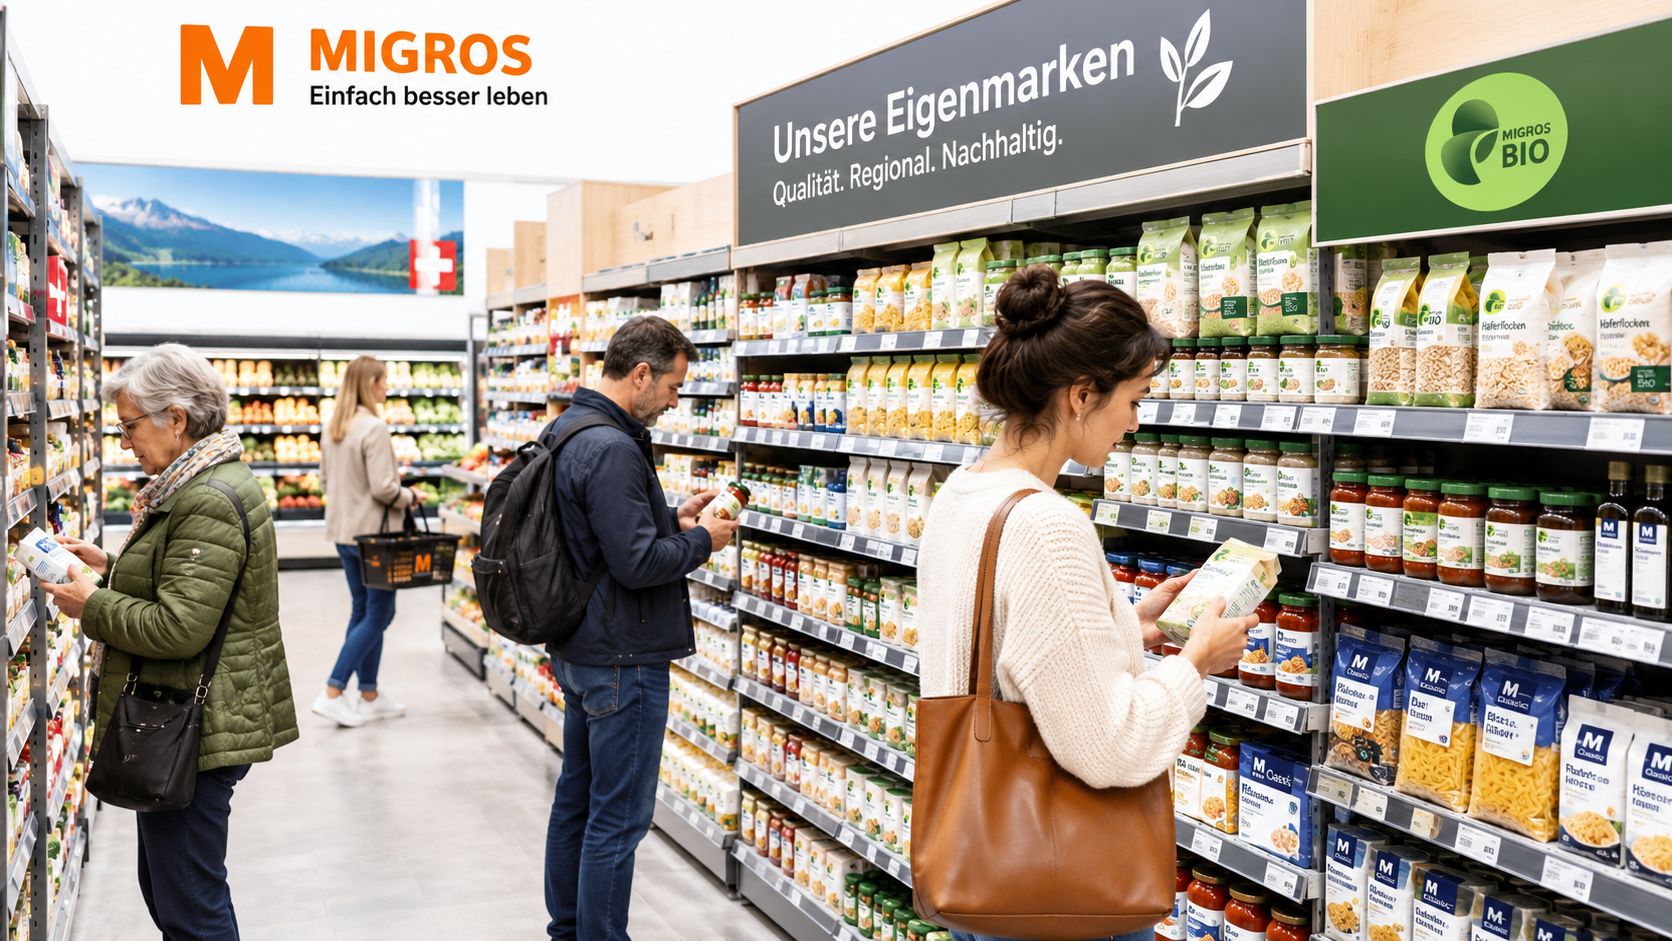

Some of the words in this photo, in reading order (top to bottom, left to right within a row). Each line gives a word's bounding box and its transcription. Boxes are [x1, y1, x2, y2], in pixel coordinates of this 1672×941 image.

[310, 28, 533, 77] MIGROS
[180, 24, 274, 105] M
[310, 85, 396, 106] Einfach
[404, 85, 480, 106] besser
[487, 85, 548, 106] leben
[773, 109, 877, 164] Unsere
[886, 39, 1135, 139] Eigenmarken
[1502, 122, 1551, 141] MIGROS
[1502, 138, 1550, 169] BIO
[773, 168, 845, 208] Qualität.
[850, 144, 936, 191] Regional.
[942, 120, 1064, 170] Nachhaltig.
[1603, 521, 1615, 532] M
[1641, 525, 1653, 537] M
[415, 553, 432, 573] M
[1351, 654, 1369, 670] M
[1425, 667, 1441, 684] M
[1502, 680, 1520, 698] M
[1582, 731, 1605, 752] M
[1253, 756, 1265, 773] M
[1650, 751, 1672, 772] M
[1337, 838, 1350, 855] M
[1379, 859, 1394, 876] M
[1425, 879, 1438, 896] M
[1487, 906, 1503, 925] M
